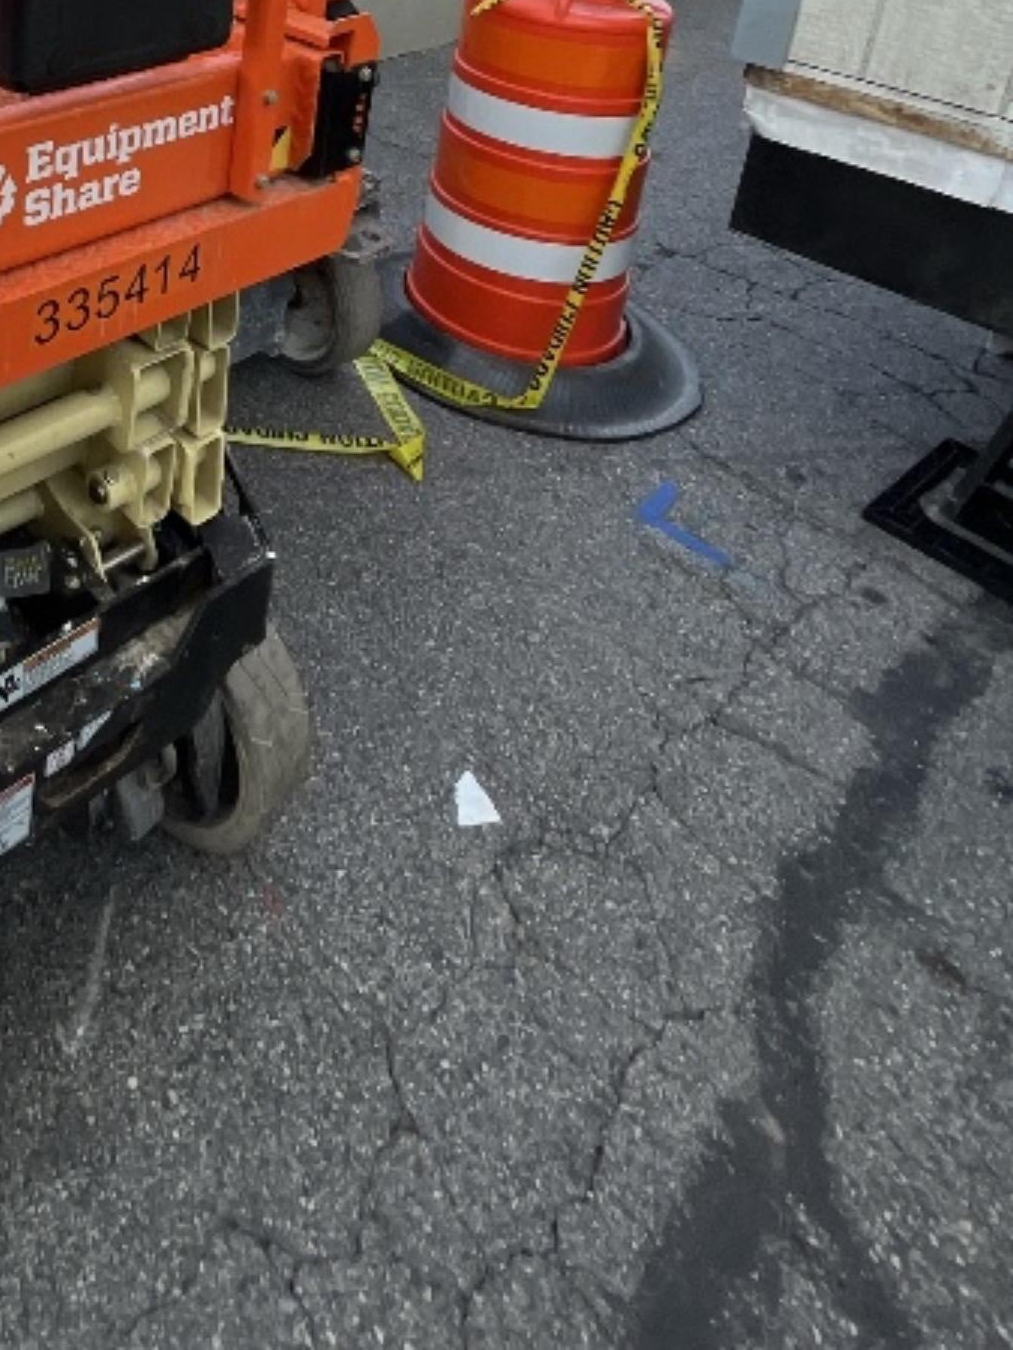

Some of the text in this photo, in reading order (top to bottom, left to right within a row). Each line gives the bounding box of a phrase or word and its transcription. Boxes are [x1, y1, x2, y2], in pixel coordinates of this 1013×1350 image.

[25, 95, 235, 184] Equipment
[22, 167, 142, 227] Share
[34, 242, 202, 345] 335414
